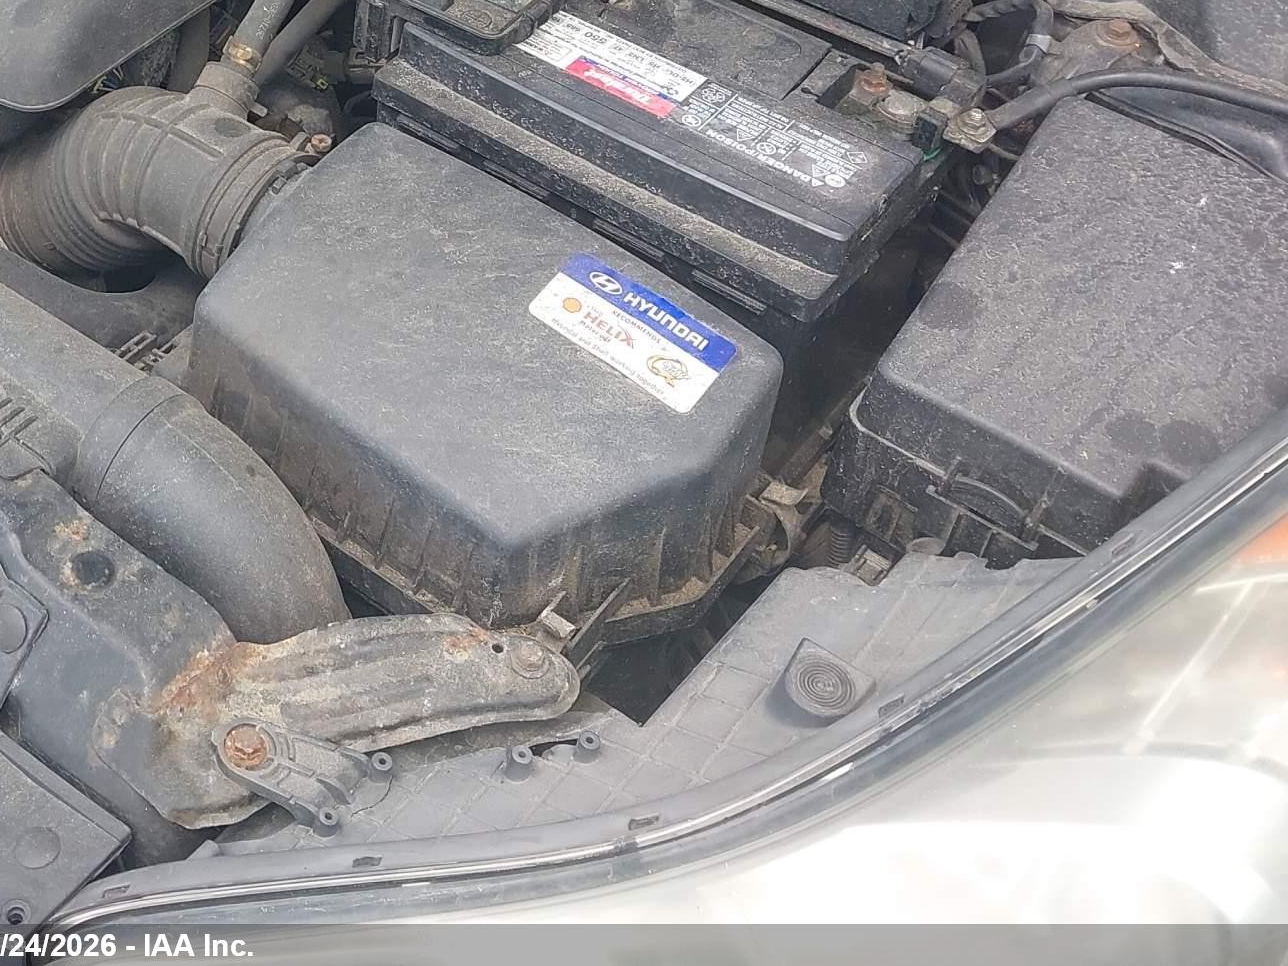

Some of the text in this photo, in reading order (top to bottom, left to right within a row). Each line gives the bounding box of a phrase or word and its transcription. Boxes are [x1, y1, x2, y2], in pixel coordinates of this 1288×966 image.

[582, 30, 607, 44] 550
[705, 129, 812, 181] DANGER/POISON
[584, 312, 635, 348] HELIX
[611, 309, 662, 344] RECOMMENDS
[623, 292, 710, 351] HYUNDAI
